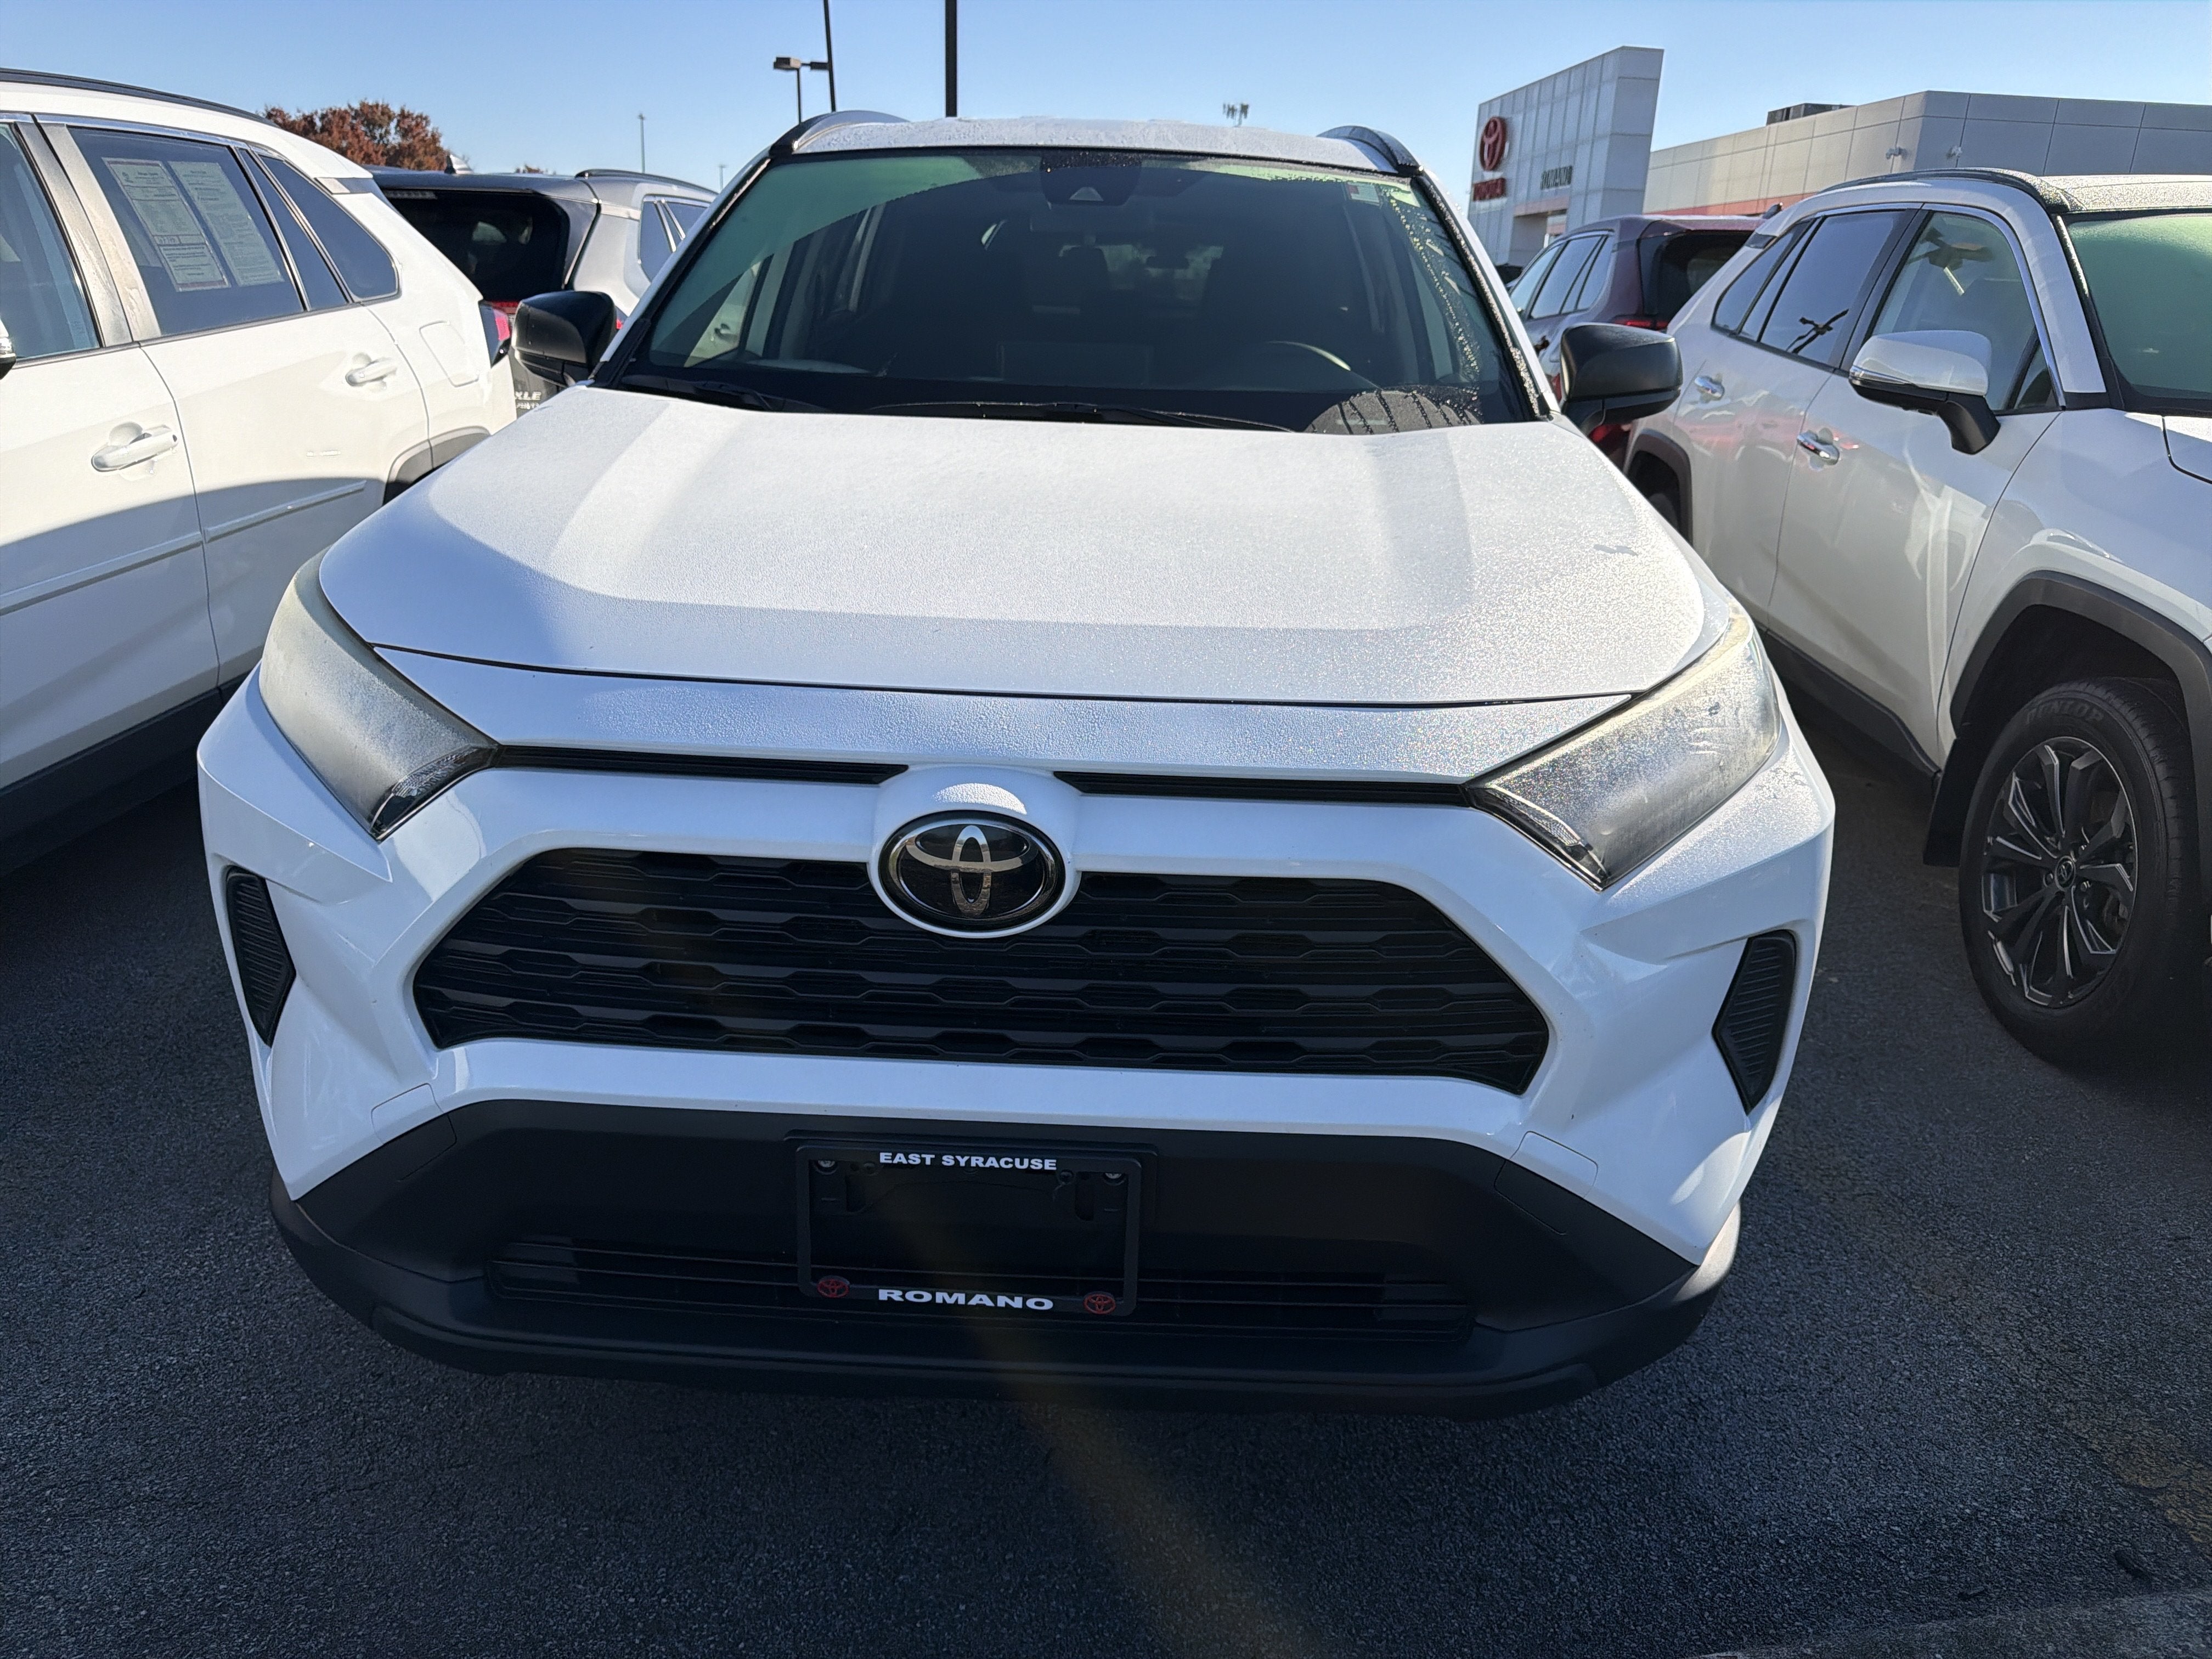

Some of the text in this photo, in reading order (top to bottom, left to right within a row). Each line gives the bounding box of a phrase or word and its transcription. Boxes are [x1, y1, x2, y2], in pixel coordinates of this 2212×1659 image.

[2025, 700, 2104, 725] DUNLOP
[879, 1152, 1057, 1170] EAST SYRACUSE
[878, 1289, 1054, 1311] ROMANO
